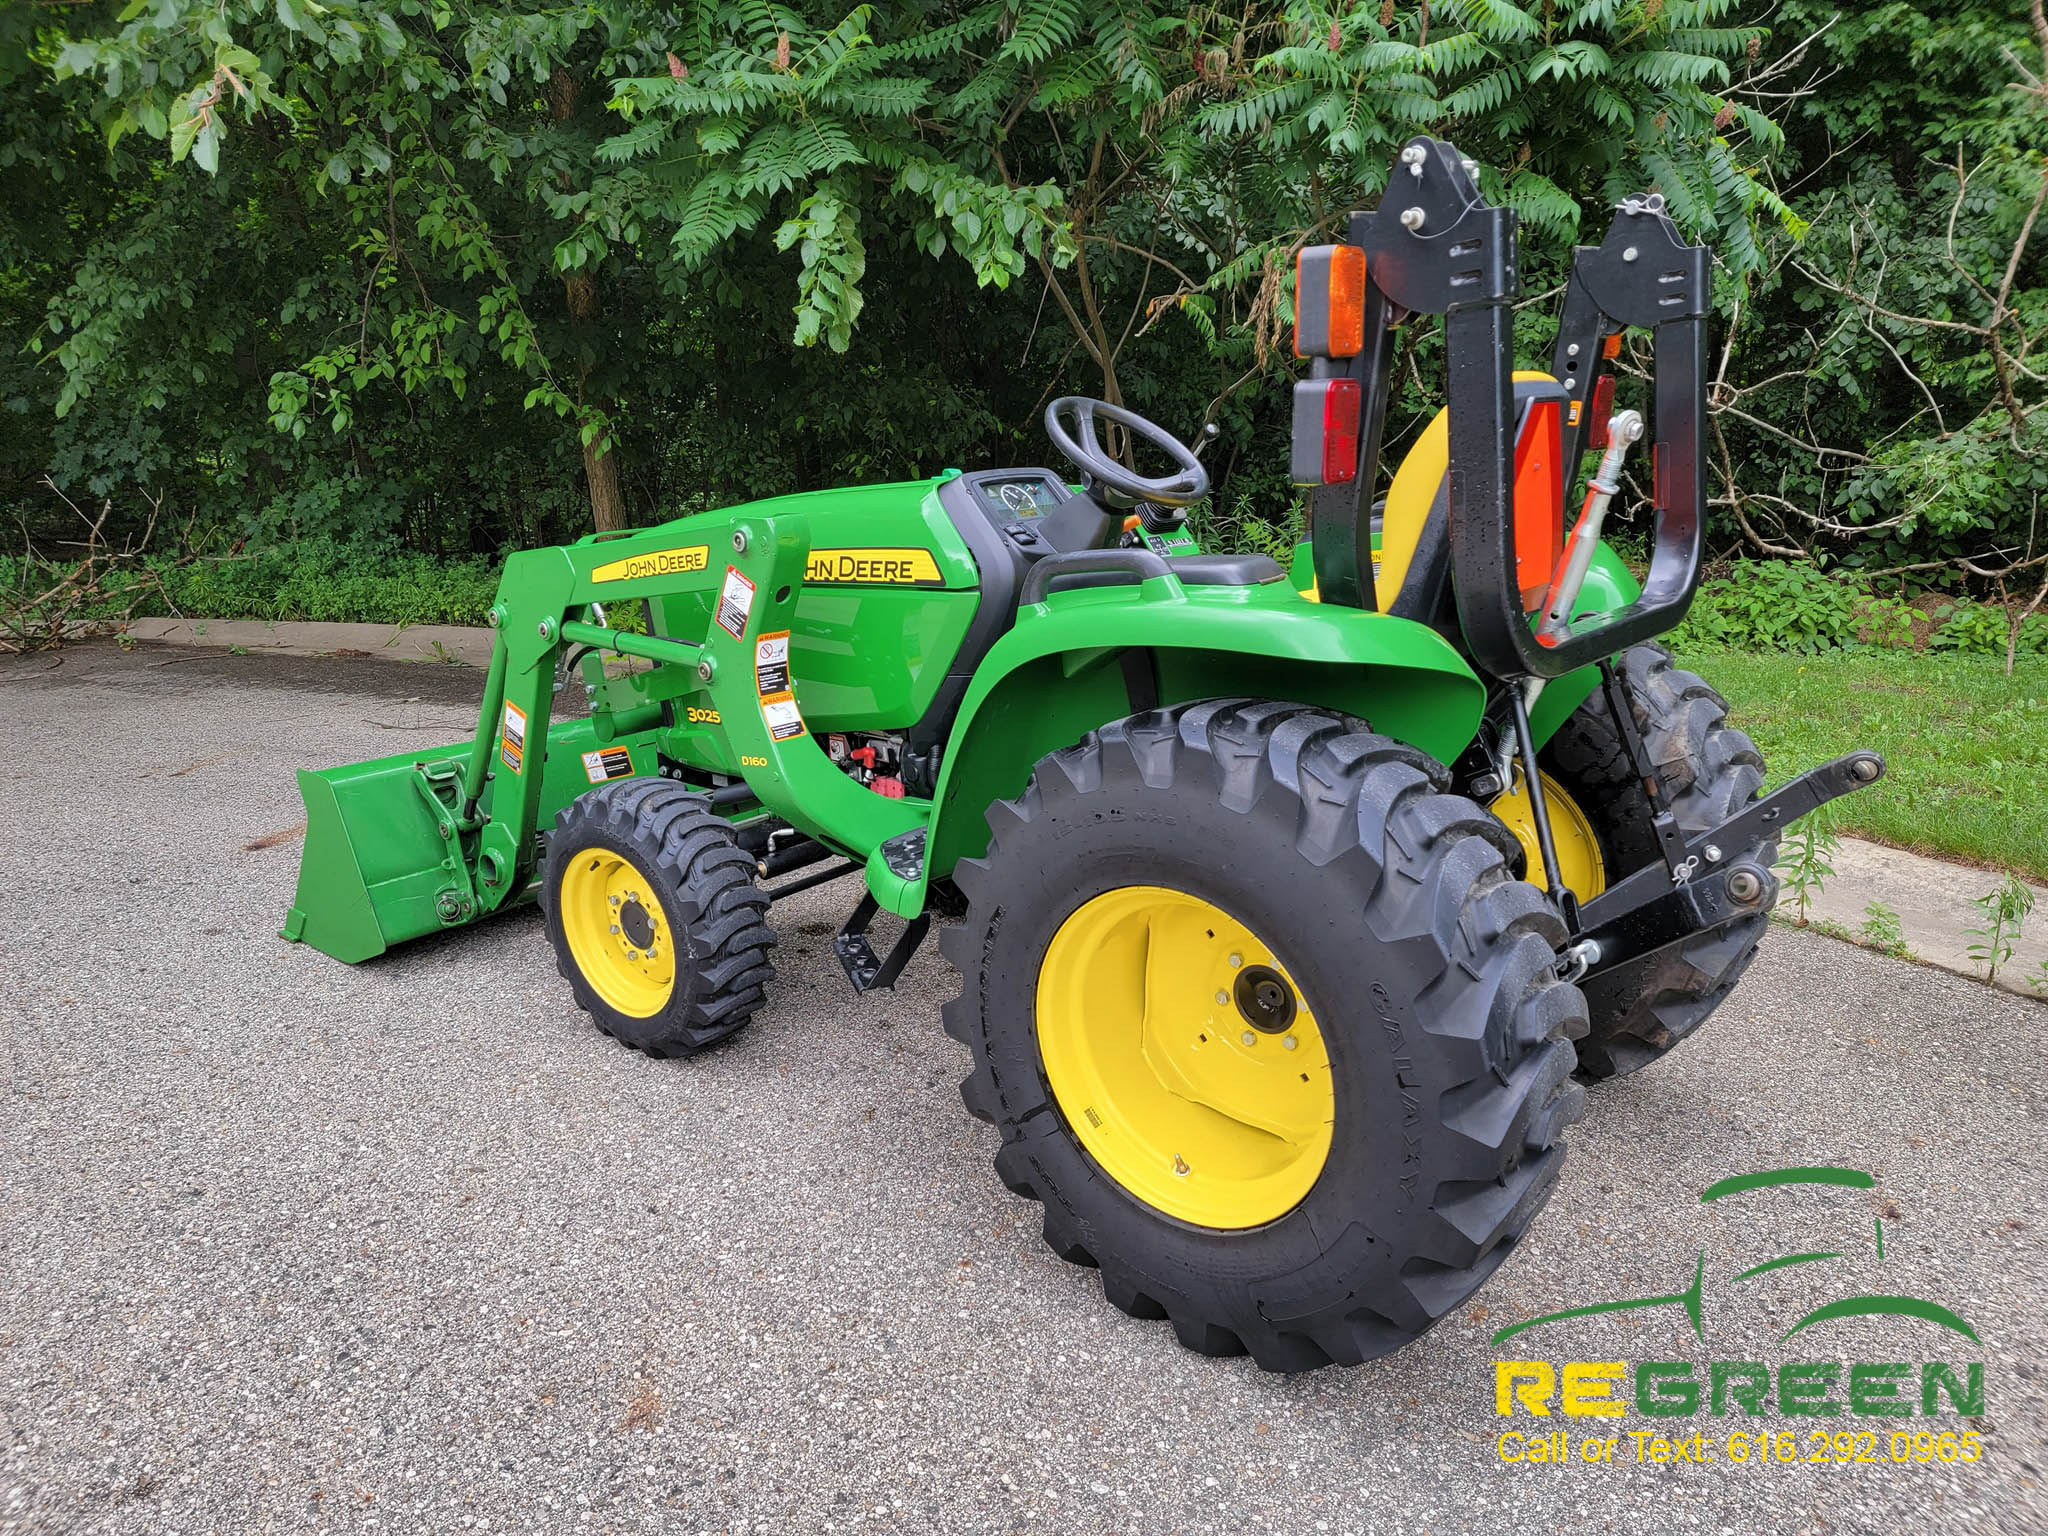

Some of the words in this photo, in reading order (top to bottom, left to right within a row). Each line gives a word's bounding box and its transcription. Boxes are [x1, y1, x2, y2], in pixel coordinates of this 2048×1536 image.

[623, 560, 656, 578] JOHN
[658, 553, 703, 571] DEERE
[804, 559, 833, 577] HN
[839, 556, 913, 579] DEERE
[687, 707, 721, 724] 3025
[741, 755, 768, 767] D160
